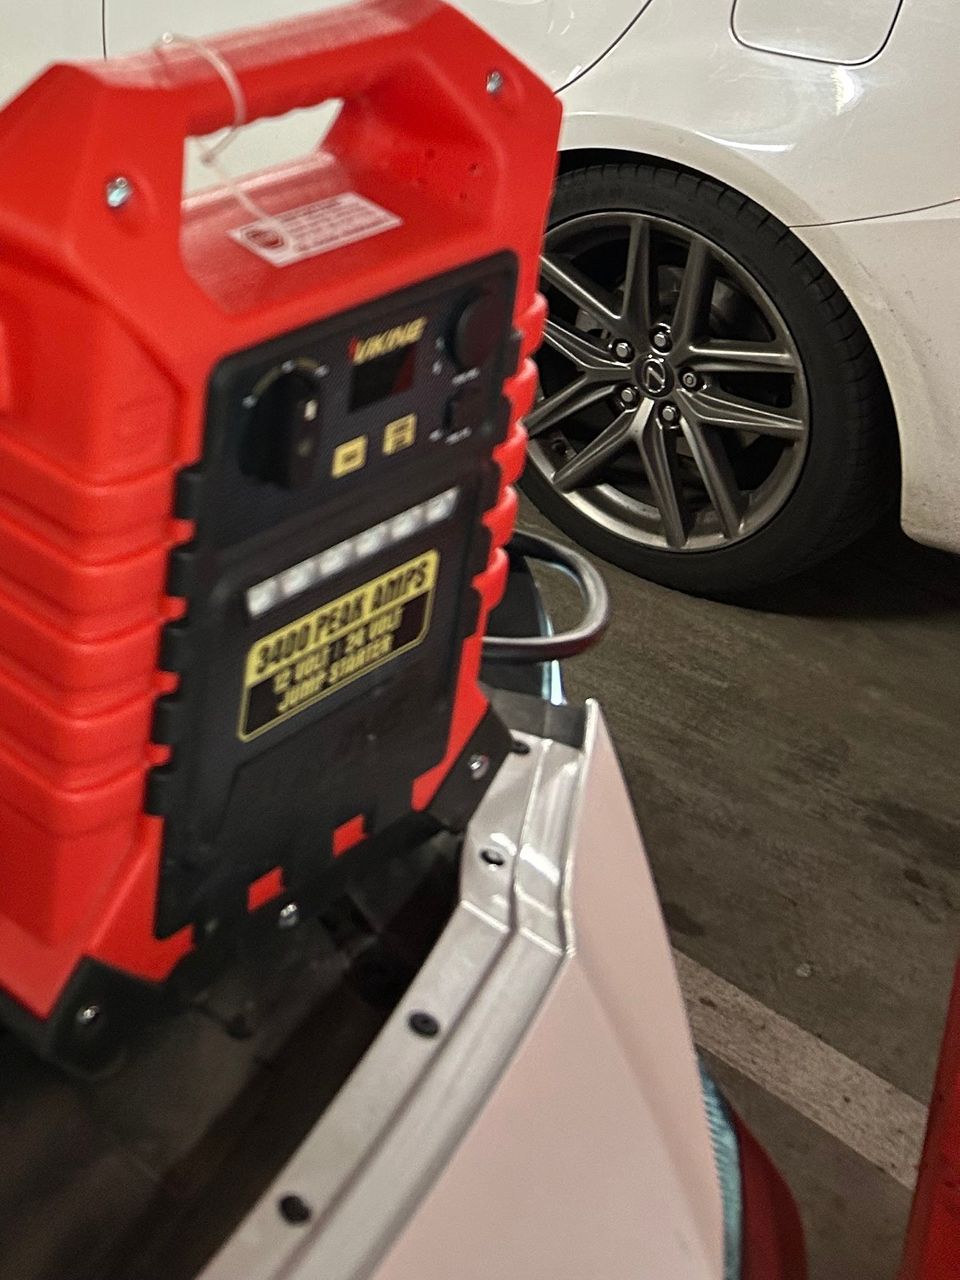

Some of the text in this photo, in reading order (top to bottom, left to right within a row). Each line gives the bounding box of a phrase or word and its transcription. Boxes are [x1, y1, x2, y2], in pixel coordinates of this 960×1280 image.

[257, 558, 429, 674] 3400 PEAK AMPS
[273, 605, 403, 695] 12 VOLT 24 VOLT
[277, 632, 393, 713] JUMP STARTER
